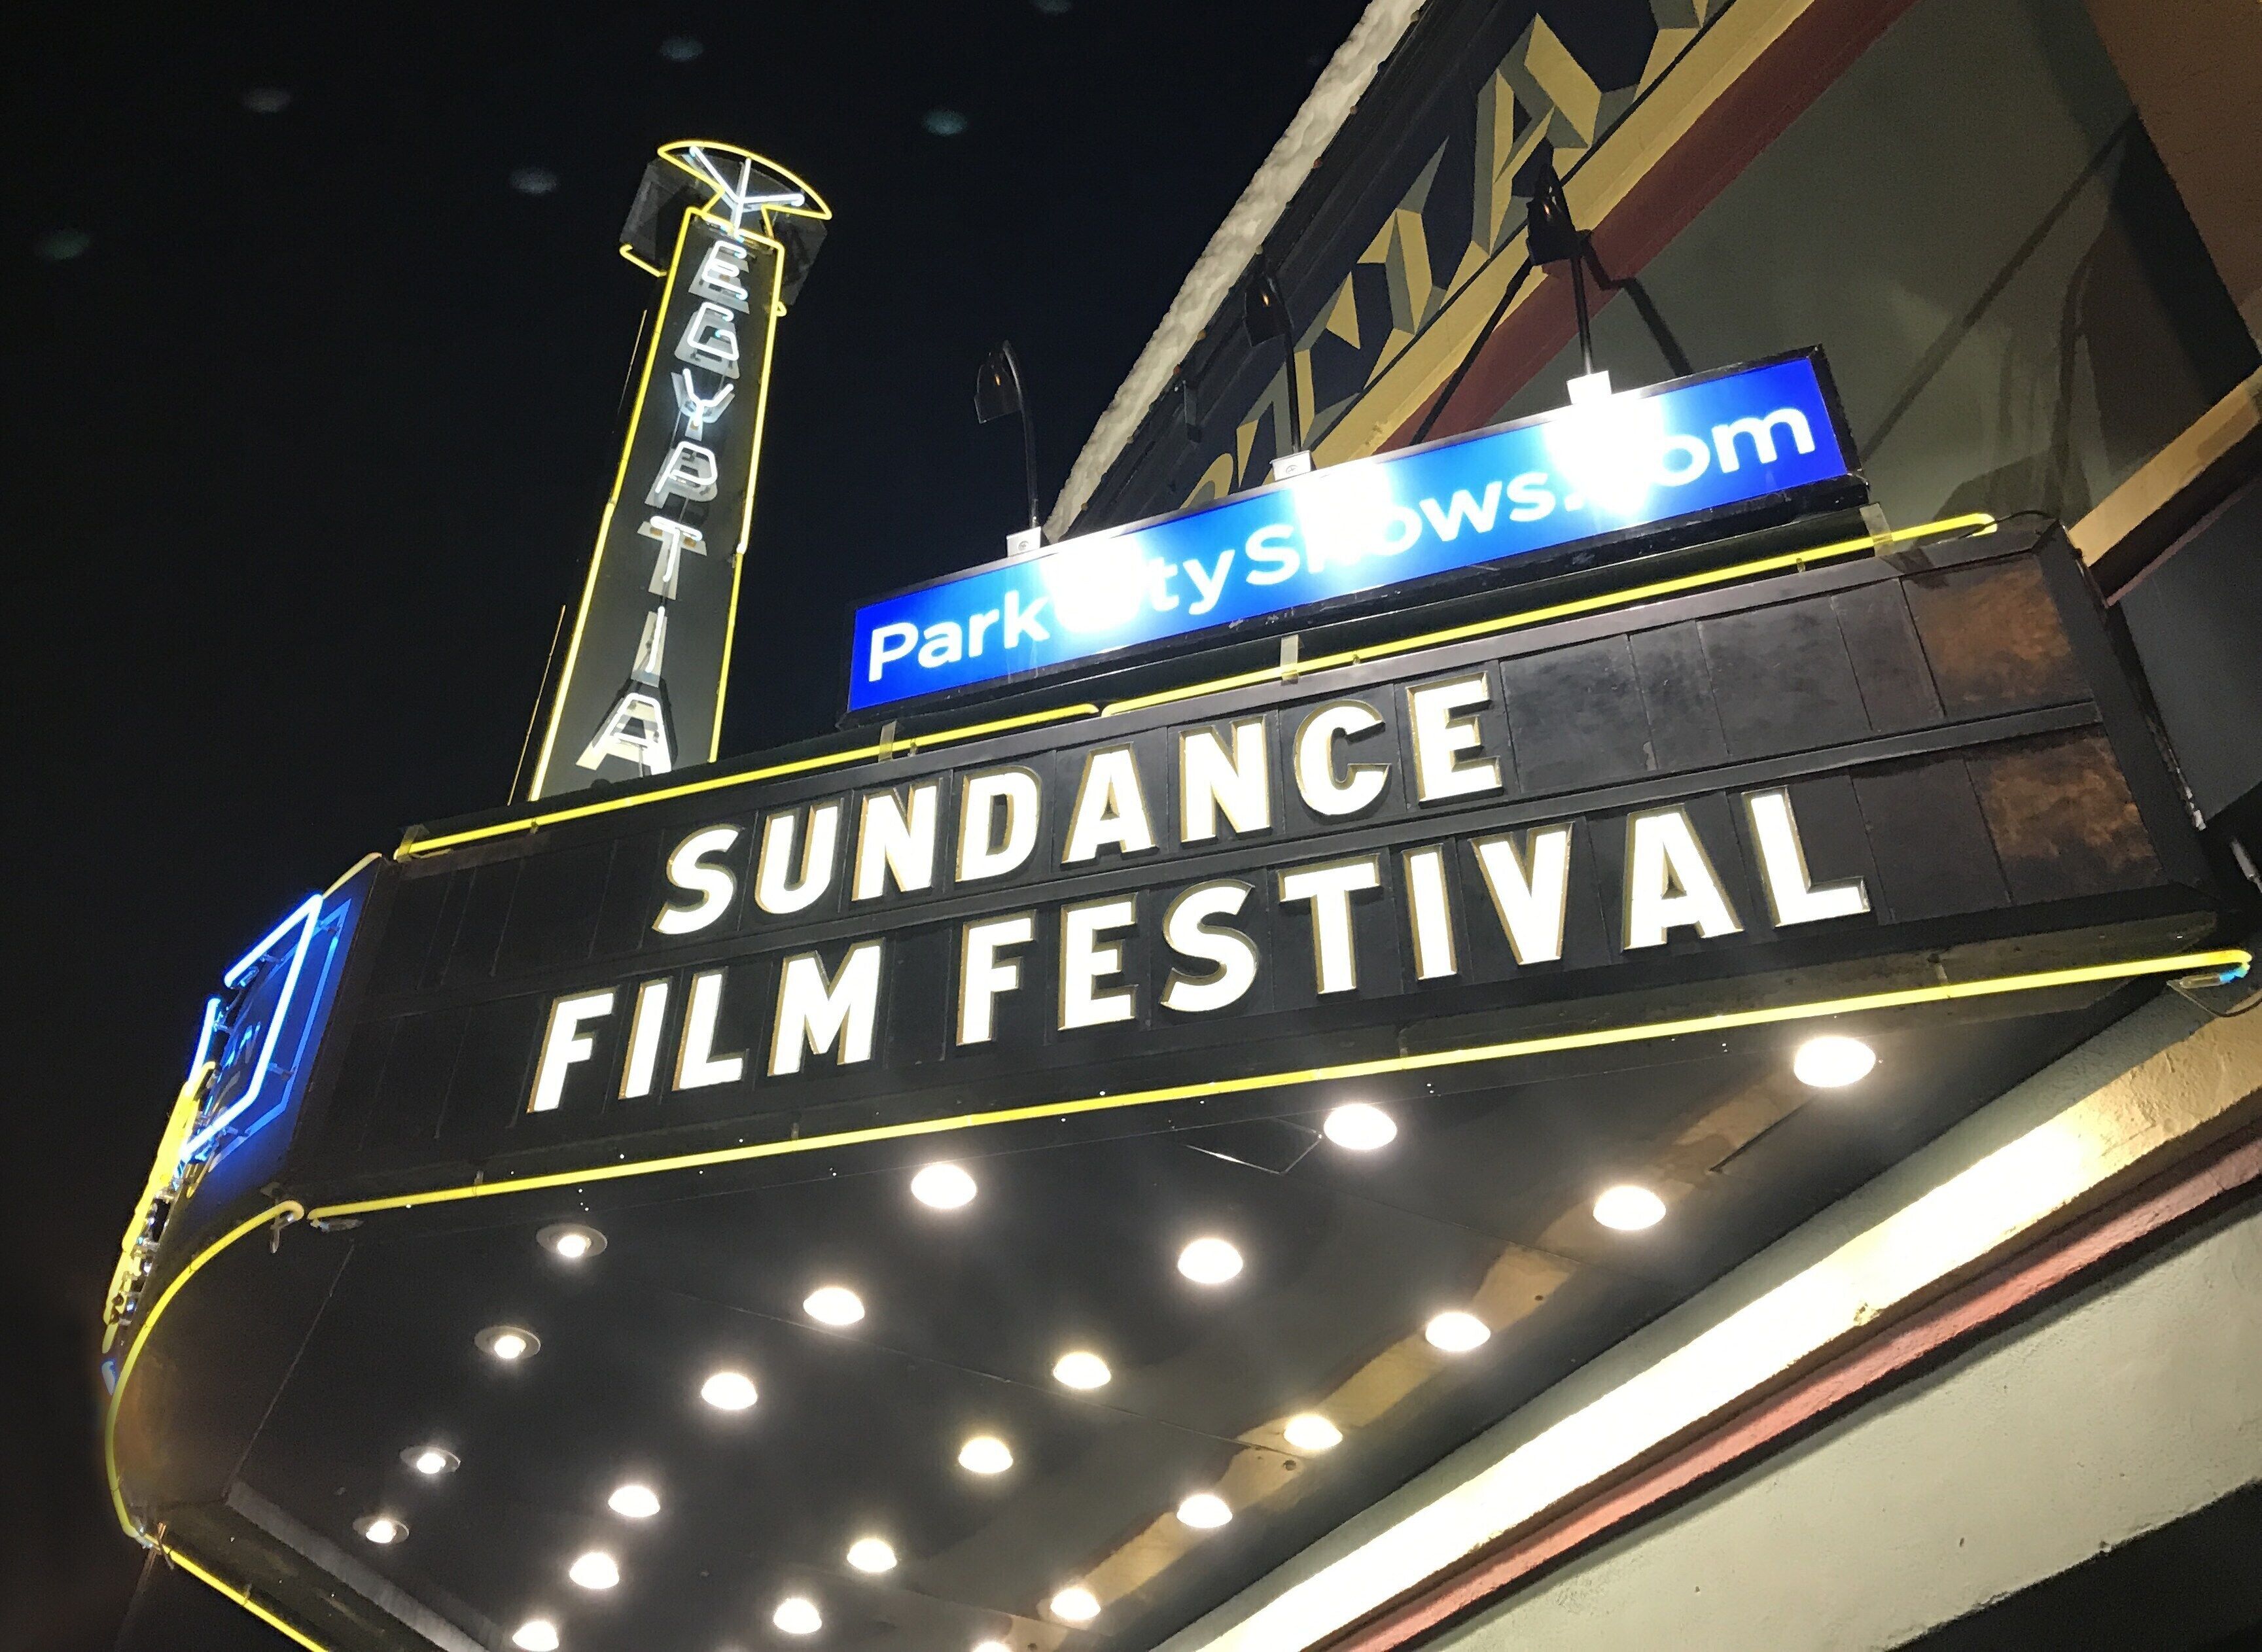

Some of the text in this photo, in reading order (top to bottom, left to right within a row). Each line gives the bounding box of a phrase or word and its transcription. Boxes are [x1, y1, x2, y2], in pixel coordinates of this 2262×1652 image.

[868, 404, 1816, 682] ParktySows.om
[653, 672, 1502, 936] SUNDANCE
[527, 785, 1871, 1114] FILM FESTIVAL
